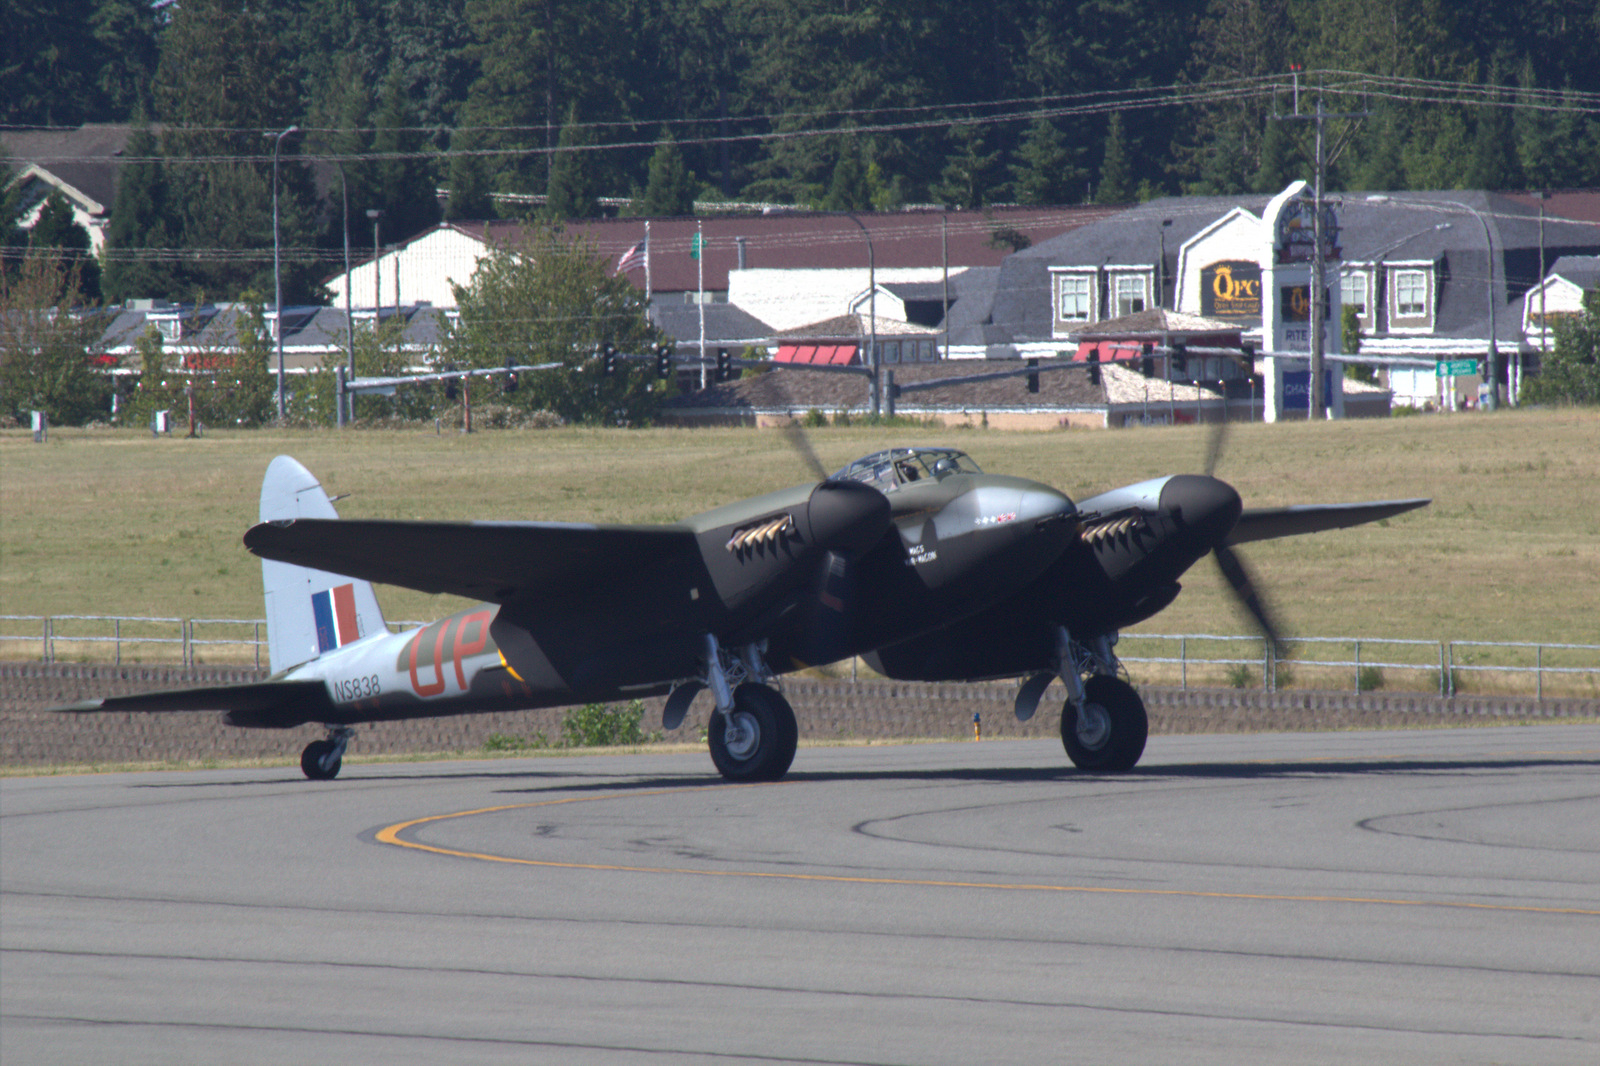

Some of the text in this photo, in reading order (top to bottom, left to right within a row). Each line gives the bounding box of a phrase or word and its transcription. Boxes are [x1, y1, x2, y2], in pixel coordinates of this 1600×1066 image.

[1213, 273, 1260, 300] QFC
[1286, 329, 1308, 341] RITE
[409, 610, 491, 697] UP
[334, 674, 381, 701] NS838
